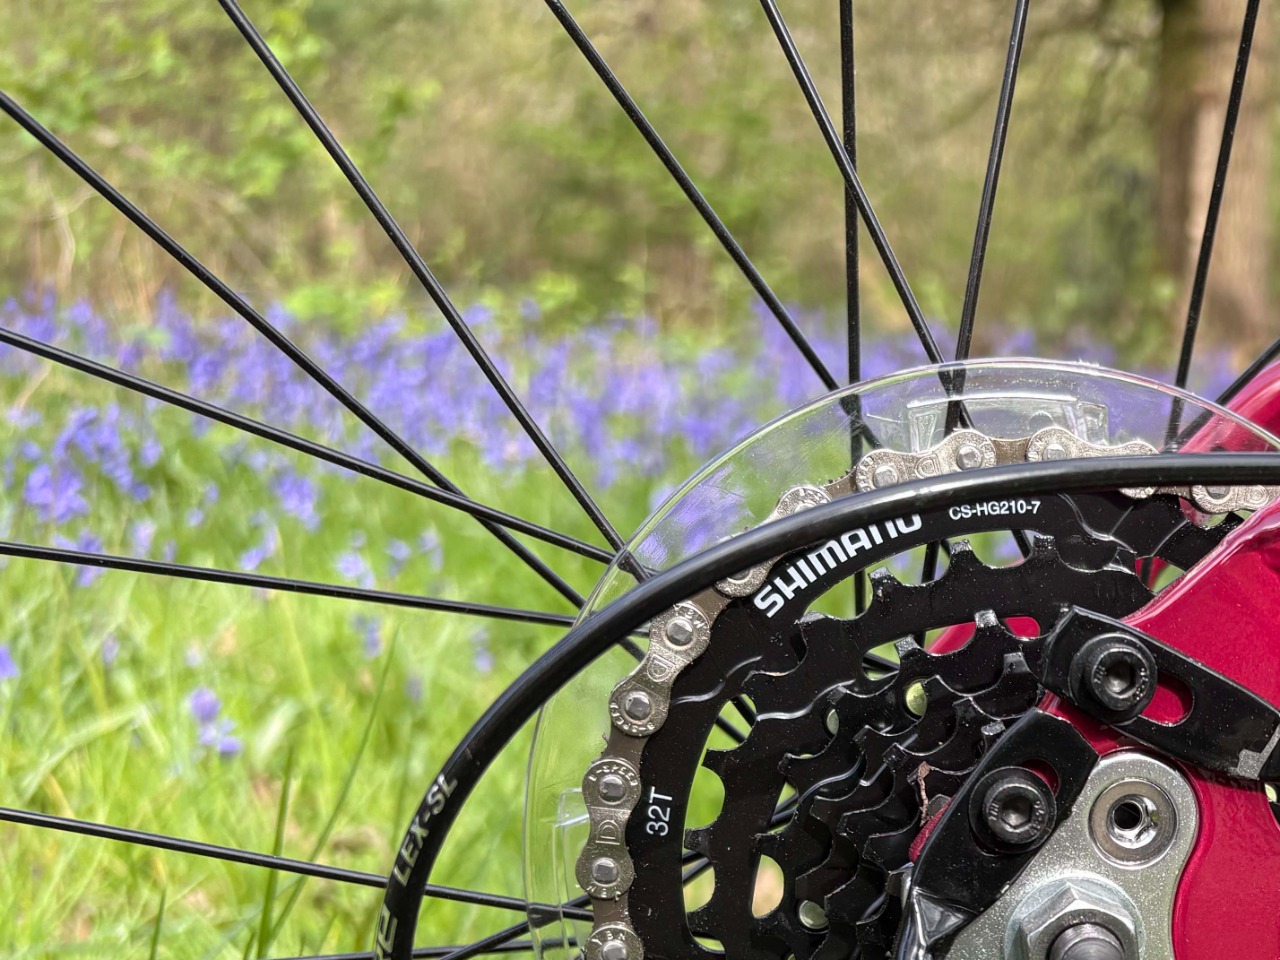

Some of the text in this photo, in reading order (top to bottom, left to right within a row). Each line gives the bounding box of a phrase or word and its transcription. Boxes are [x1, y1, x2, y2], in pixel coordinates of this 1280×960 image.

[948, 500, 1041, 522] CS-HG210-7
[392, 772, 459, 887] LEX-SL
[646, 786, 673, 836] 32T
